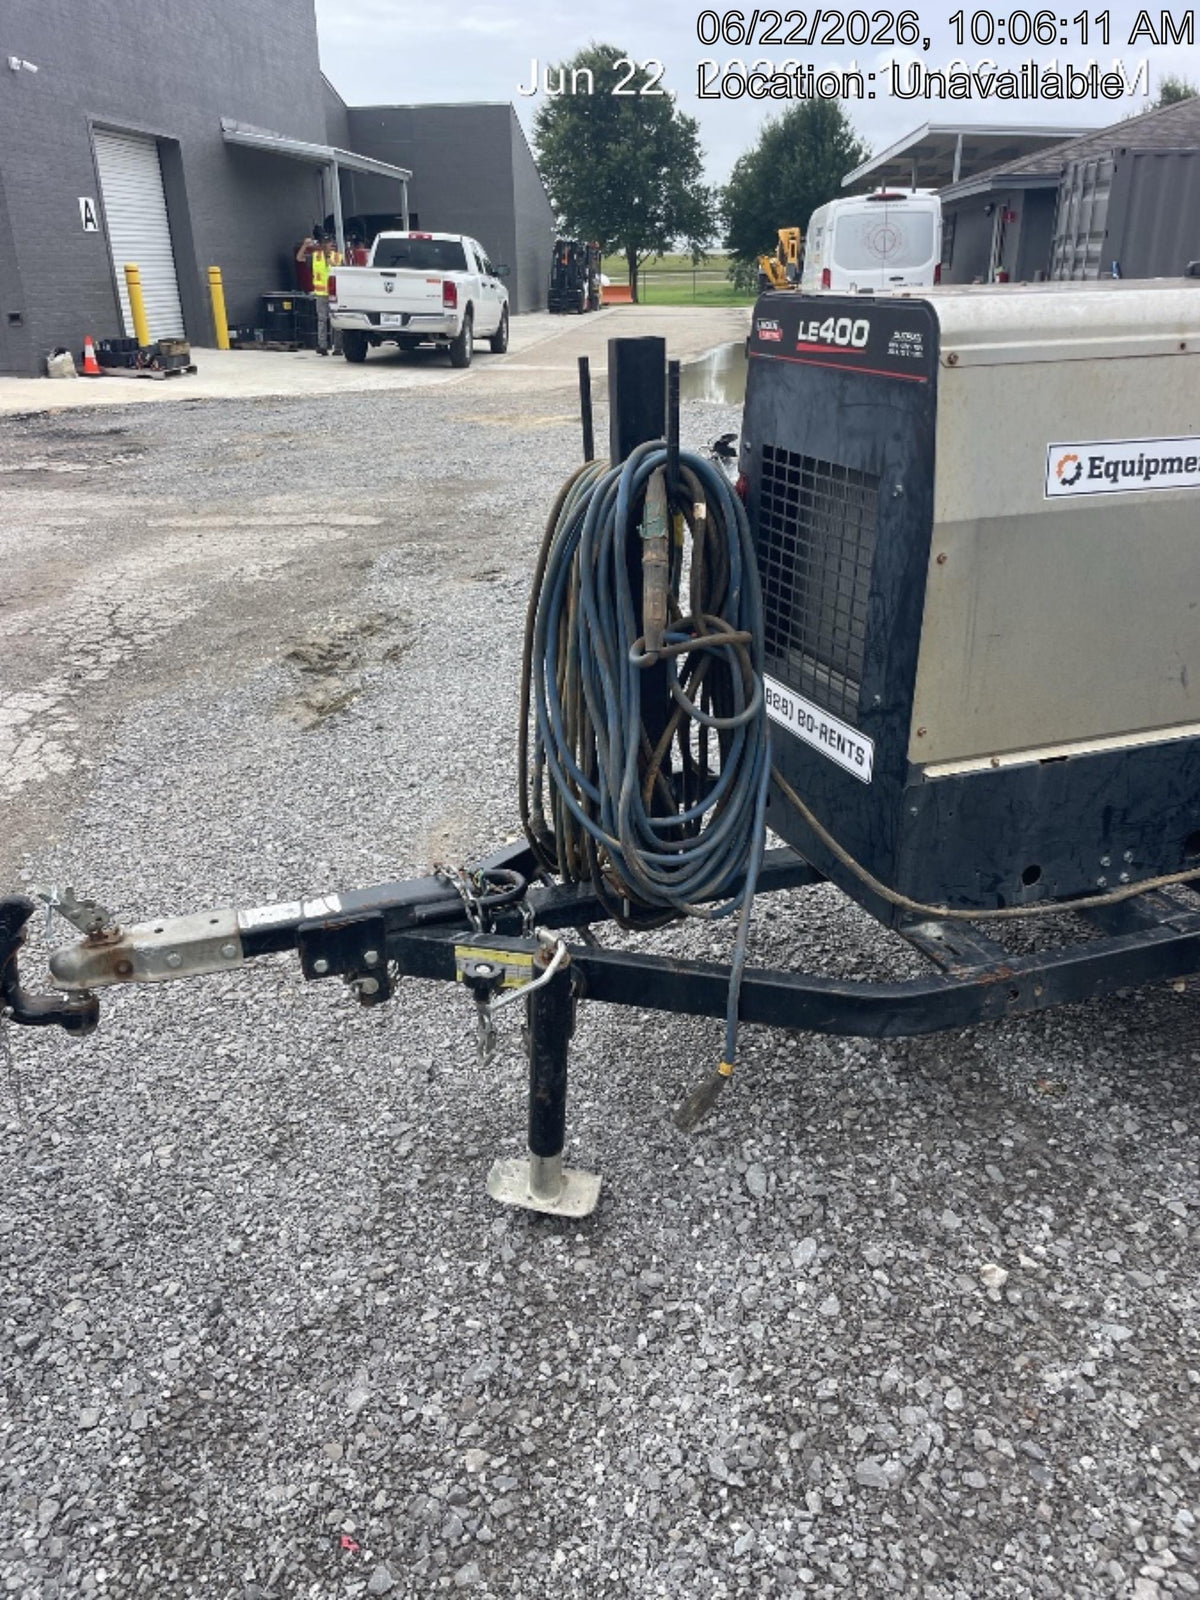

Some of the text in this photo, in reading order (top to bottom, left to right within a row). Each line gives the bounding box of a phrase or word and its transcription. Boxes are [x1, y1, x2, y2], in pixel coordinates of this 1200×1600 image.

[84, 199, 97, 230] A
[797, 317, 870, 349] LE400
[1087, 452, 1200, 484] Equipme
